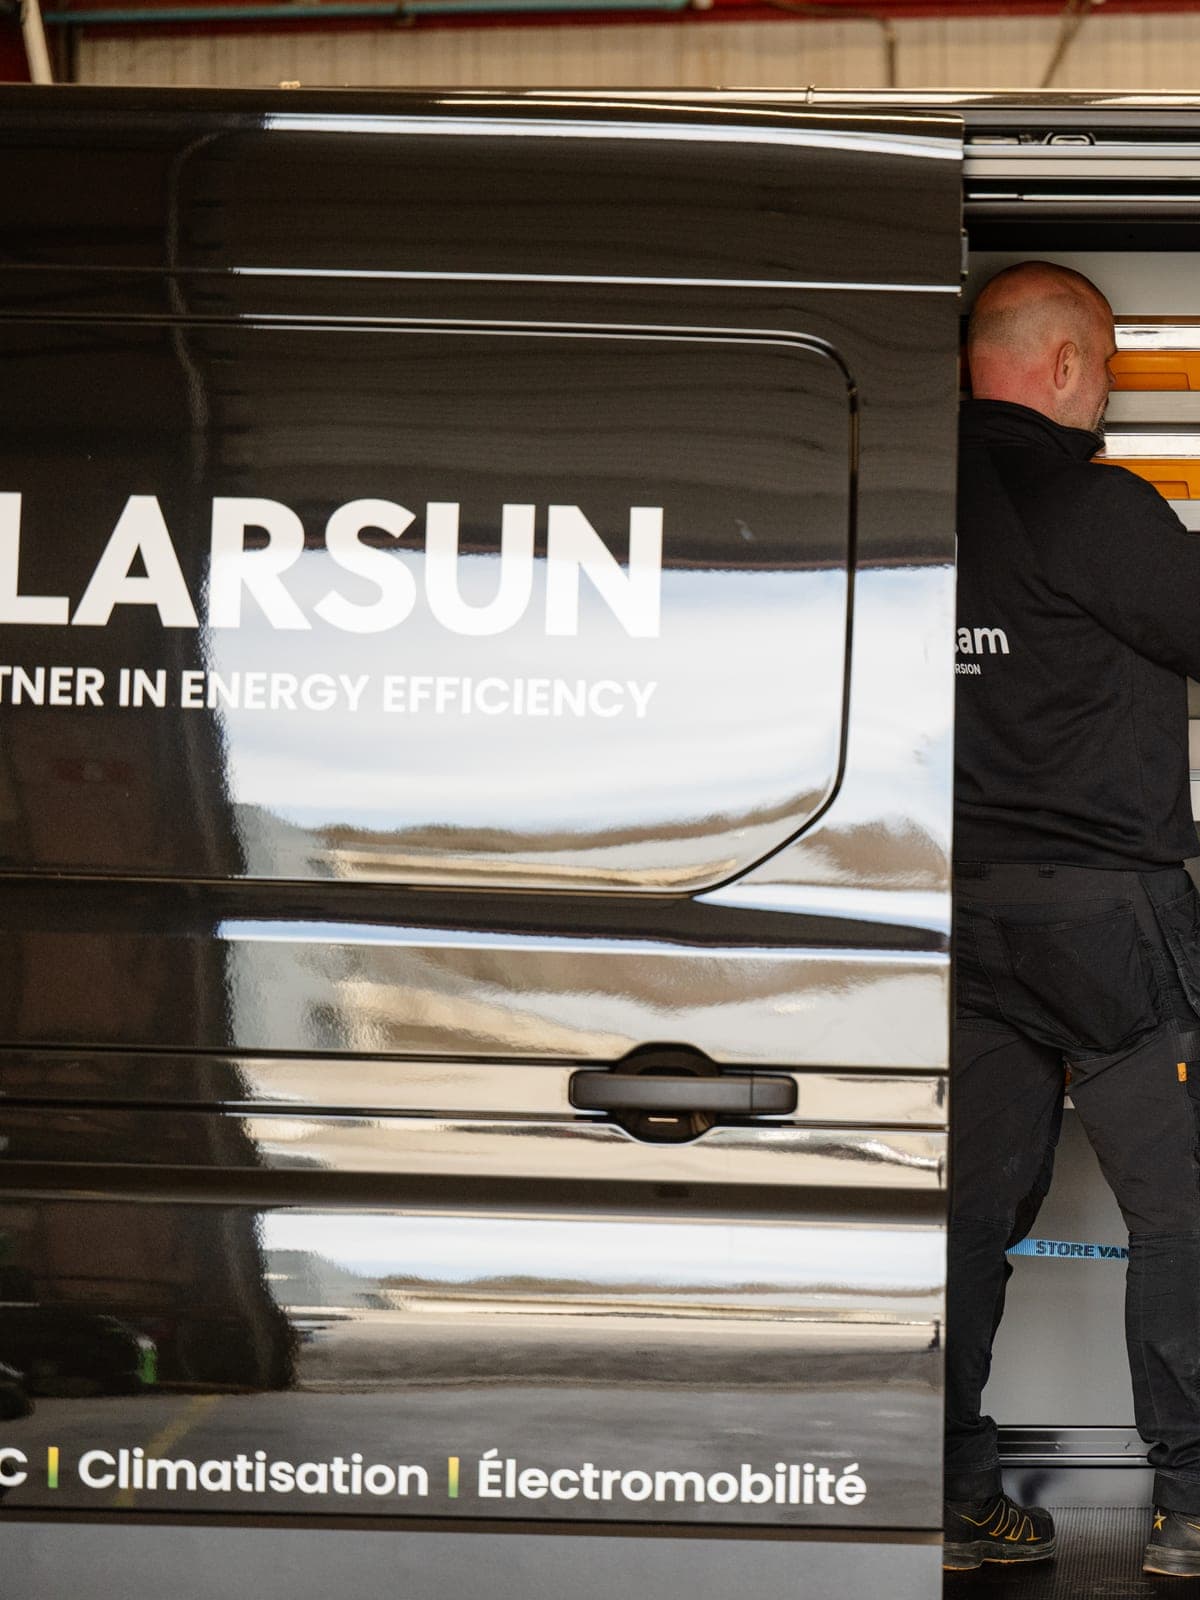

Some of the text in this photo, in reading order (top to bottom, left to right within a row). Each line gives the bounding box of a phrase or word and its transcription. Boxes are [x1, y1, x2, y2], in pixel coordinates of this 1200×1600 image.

[0, 491, 663, 638] LARSUN
[954, 627, 1010, 655] am
[119, 669, 166, 707] IN
[181, 670, 370, 712] ENERGY
[383, 674, 658, 718] EFFICIENCY
[1036, 1240, 1094, 1257] STORE
[78, 1447, 429, 1497] Climatisation
[477, 1448, 868, 1506] Électromobilité
